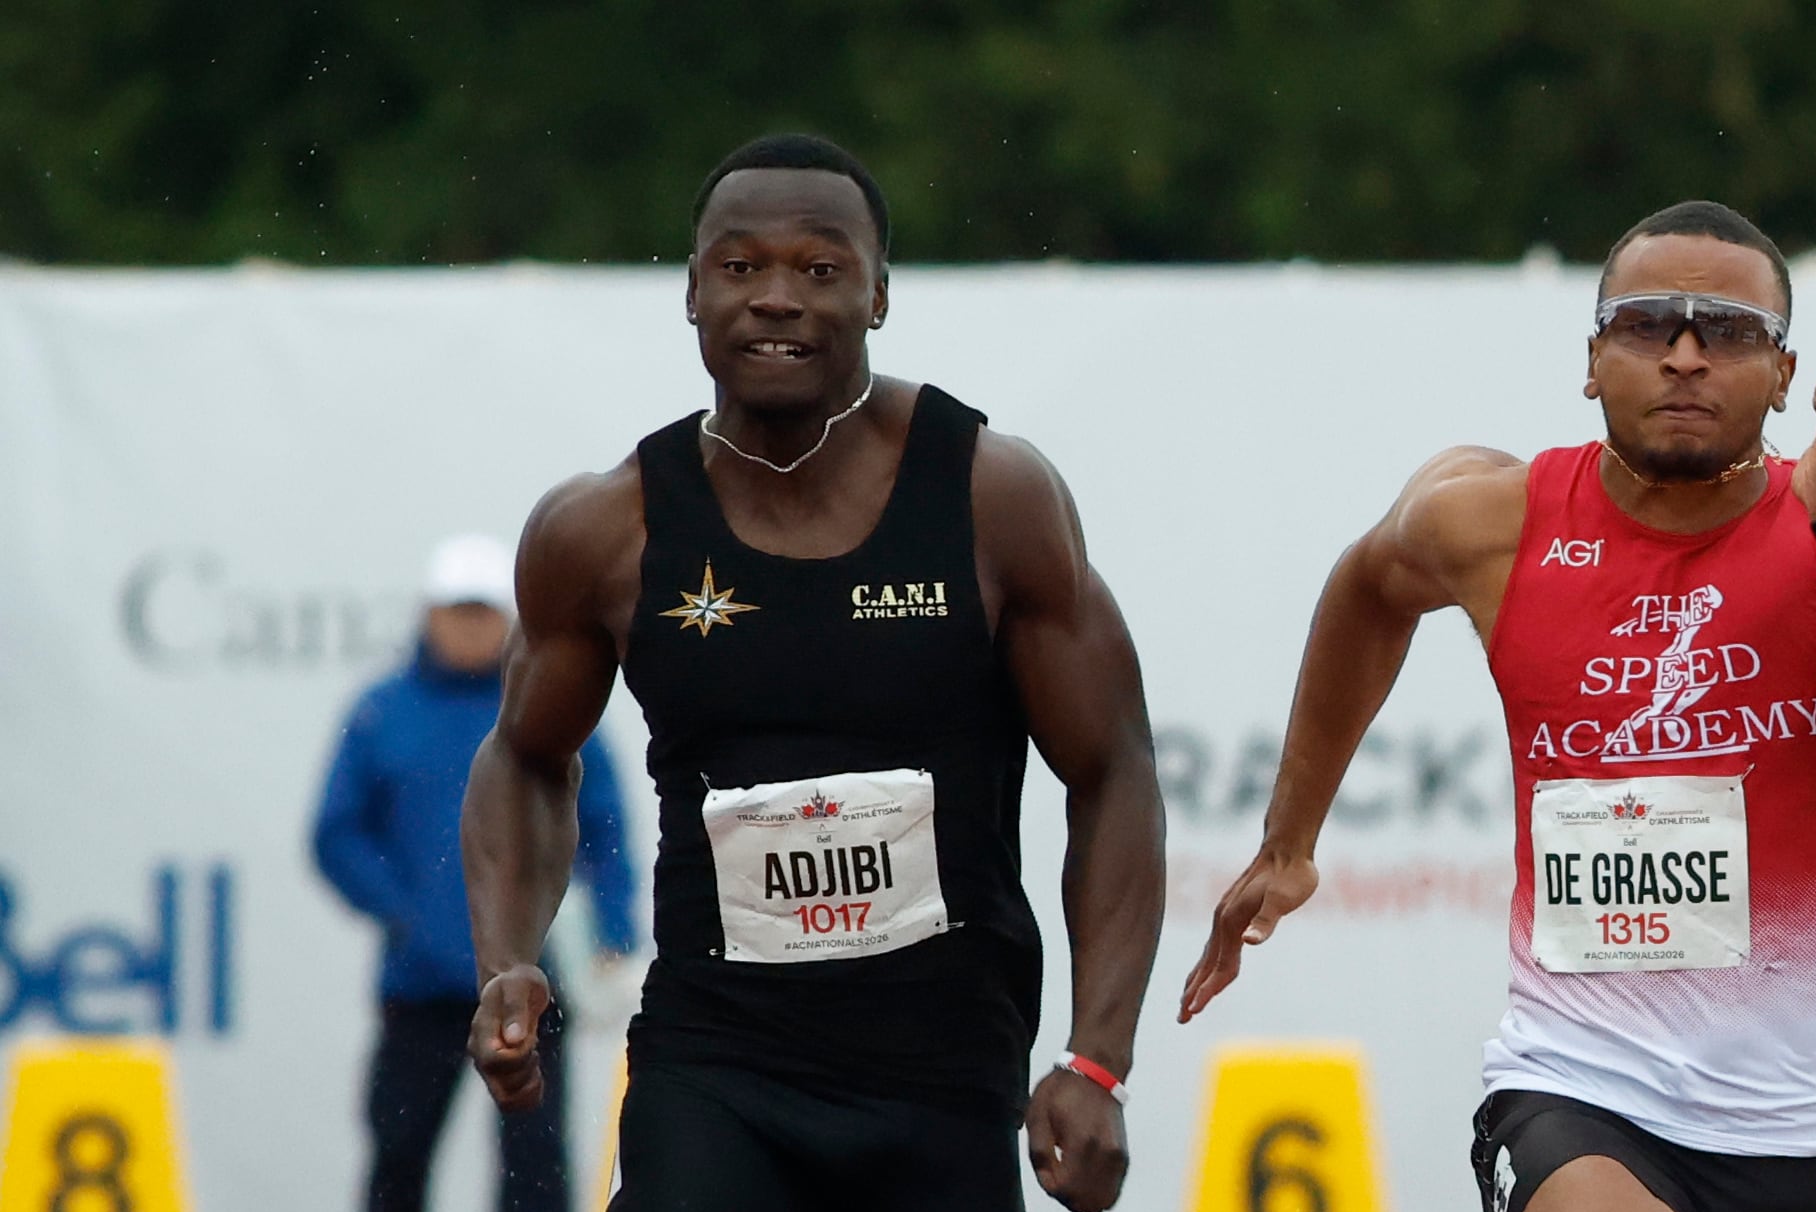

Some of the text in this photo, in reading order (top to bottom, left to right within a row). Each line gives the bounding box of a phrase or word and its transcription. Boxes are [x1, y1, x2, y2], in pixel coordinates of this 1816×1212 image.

[1540, 537, 1605, 567] AG1
[851, 582, 945, 607] C.A.N.I
[1631, 587, 1715, 634] THE
[852, 605, 949, 620] ATHLETICS
[1579, 643, 1761, 696] SPEED
[764, 840, 893, 900] ADJIBI
[1545, 853, 1582, 905] DE
[1592, 851, 1730, 906] GRASSE
[793, 901, 872, 934] 1017
[1595, 912, 1671, 945] 1315
[784, 933, 889, 951] #ACNATIONALS2026
[1583, 950, 1685, 961] #ACNATIONALS2026
